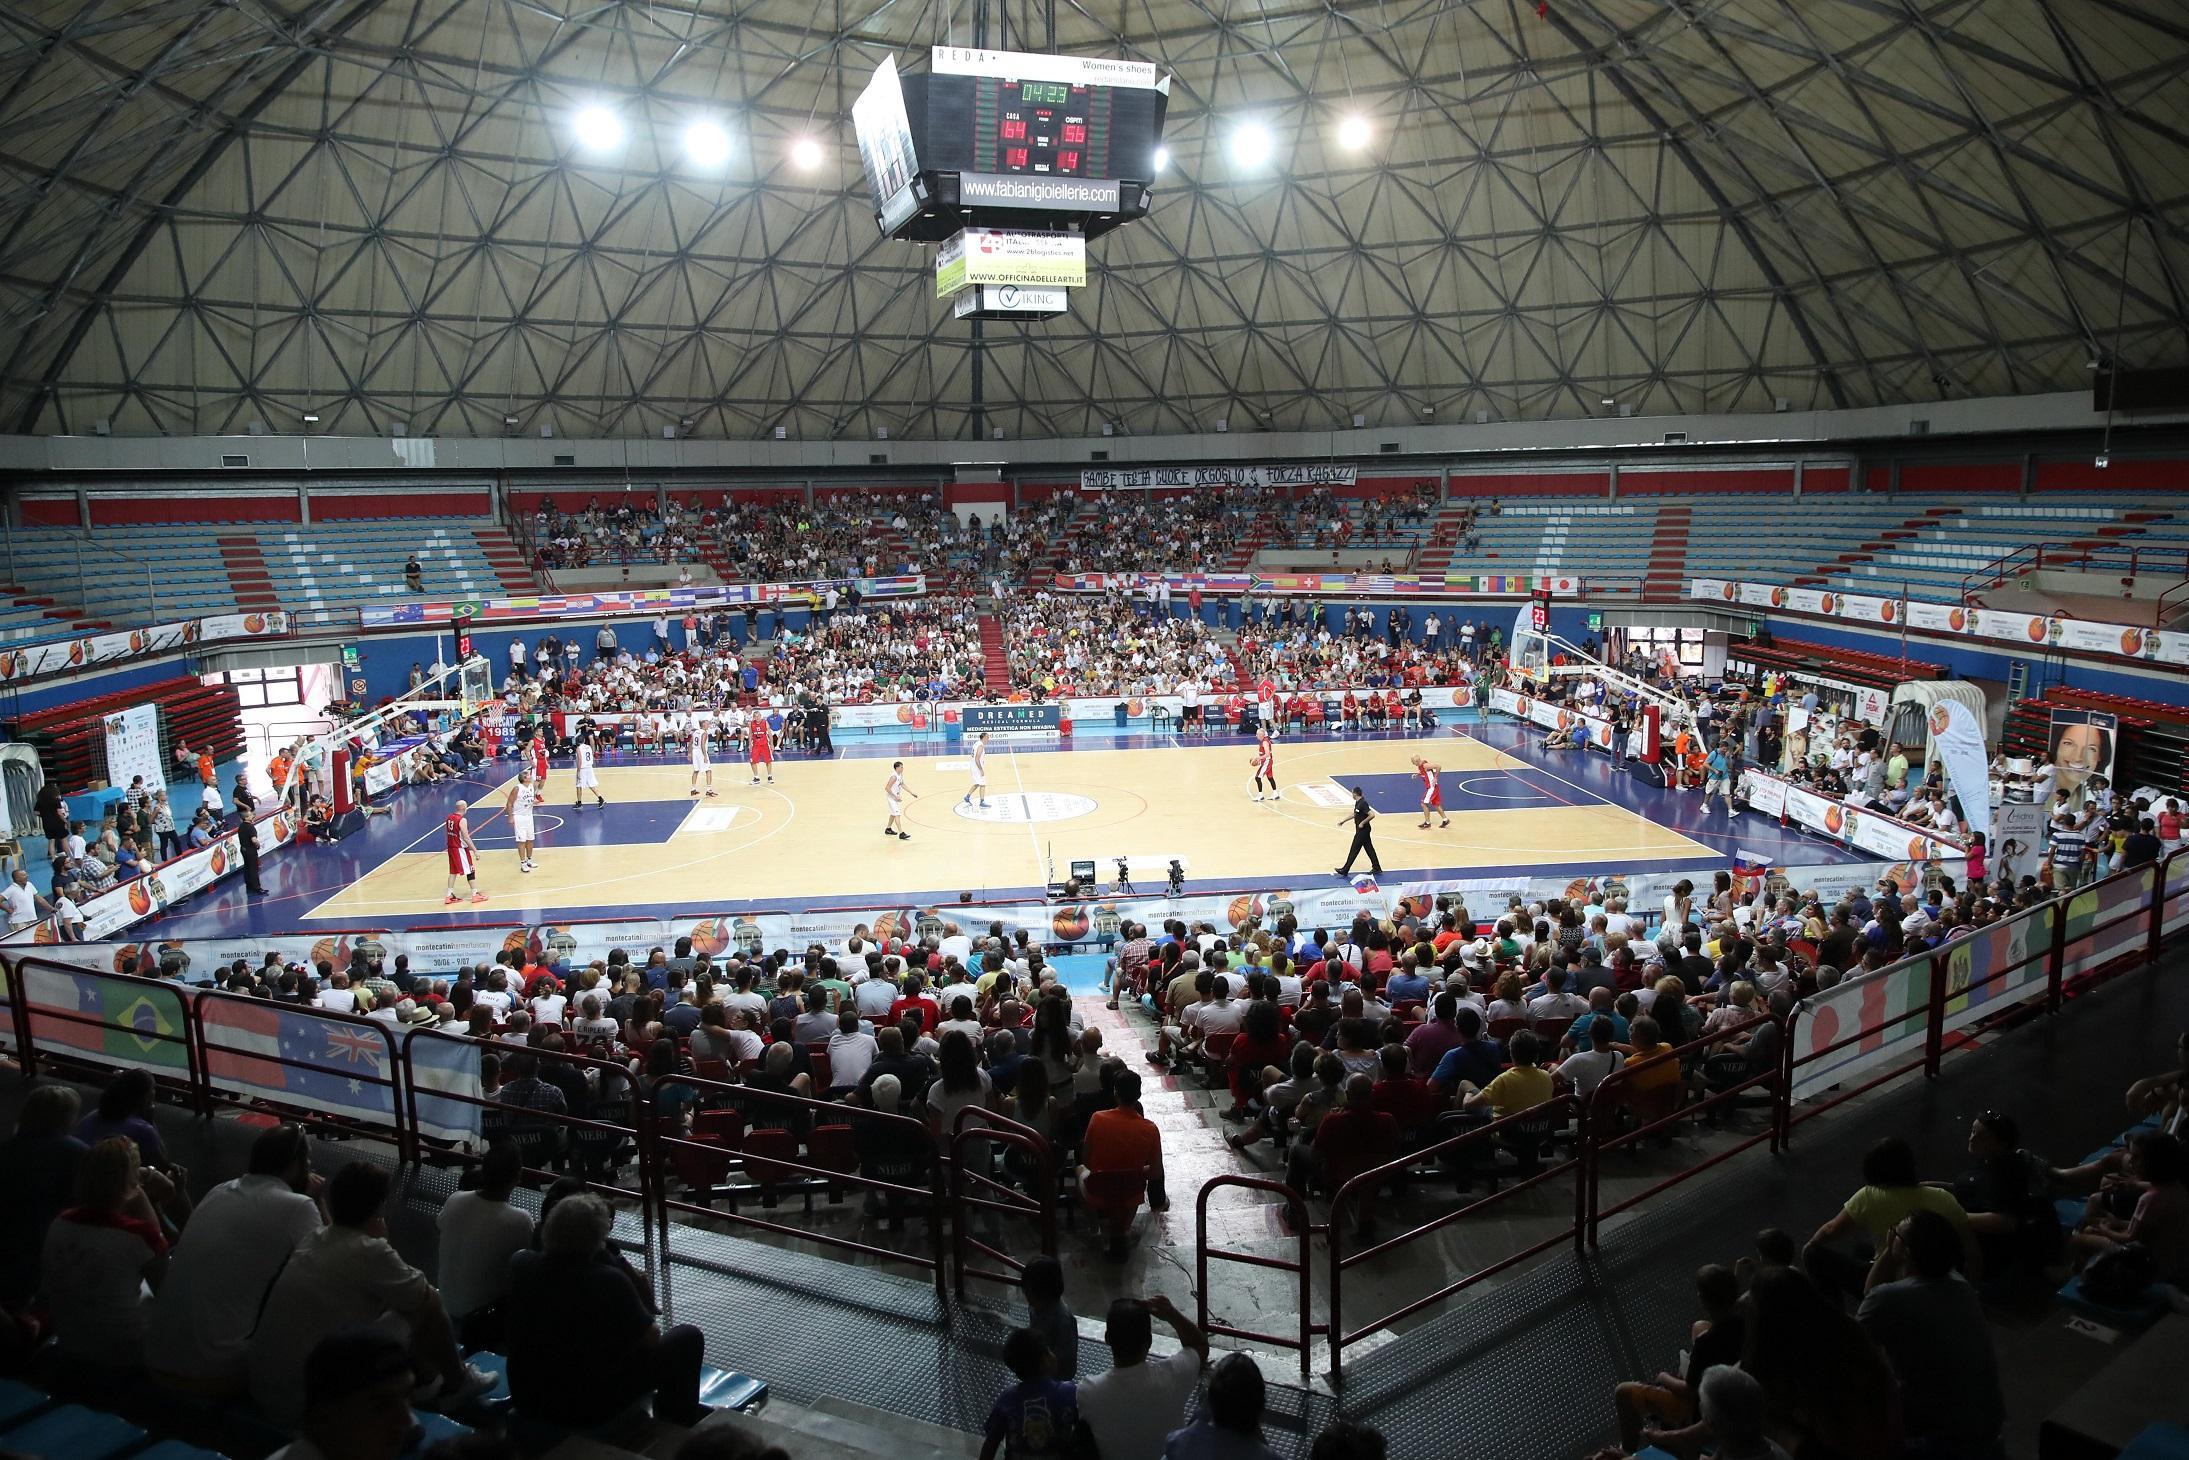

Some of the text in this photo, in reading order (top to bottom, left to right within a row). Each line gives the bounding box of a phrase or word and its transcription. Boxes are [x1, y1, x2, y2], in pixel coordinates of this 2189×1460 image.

[938, 48, 985, 62] REDA
[1126, 65, 1152, 74] shoes
[1006, 112, 1020, 120] CASA
[1005, 121, 1026, 138] 64
[964, 180, 1118, 203] www.fabianigioiellerie.com
[970, 273, 1083, 284] WWW.OFFICINADELLEARTI.IT
[1534, 609, 1545, 624] 23
[488, 728, 516, 737] 1989
[694, 737, 699, 746] 9
[585, 751, 592, 761] 8
[448, 820, 454, 830] 13
[434, 958, 450, 966] 30/06
[457, 957, 469, 965] 9/07
